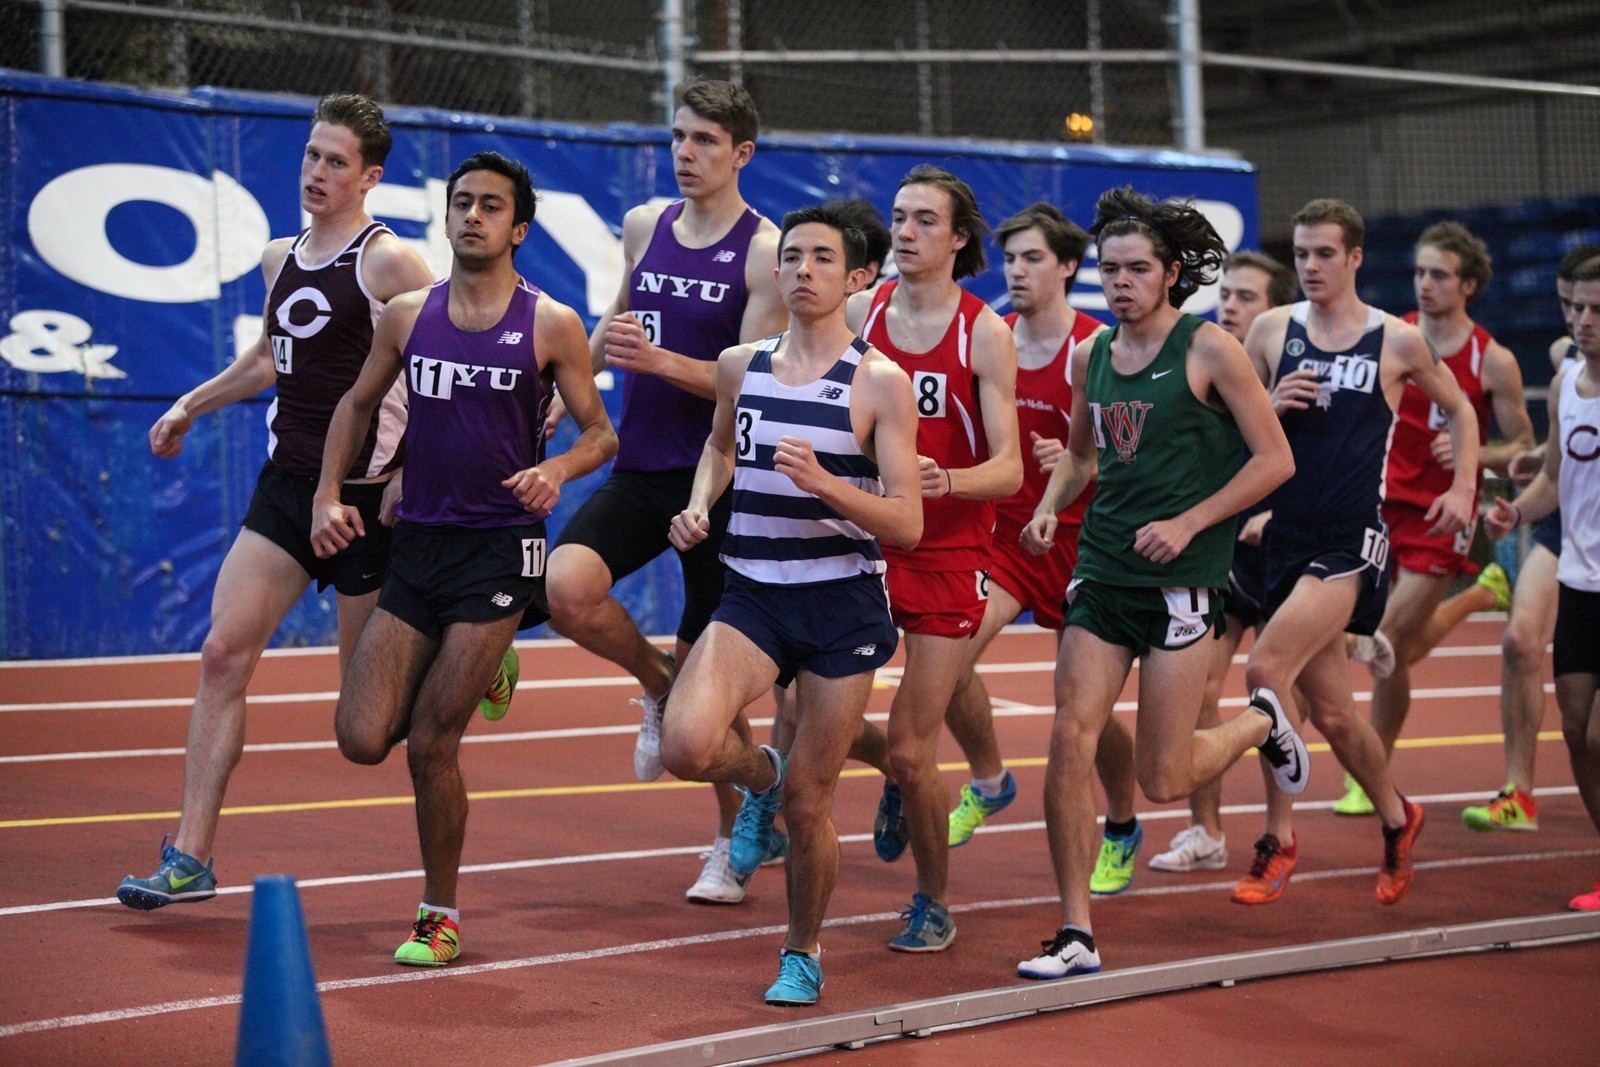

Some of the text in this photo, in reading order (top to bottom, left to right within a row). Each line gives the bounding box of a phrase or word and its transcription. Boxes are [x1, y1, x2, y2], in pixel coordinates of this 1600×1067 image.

[636, 271, 731, 303] NYU
[275, 286, 333, 339] C
[273, 337, 288, 371] 14
[413, 358, 443, 396] 11
[454, 362, 523, 391] YU
[1338, 359, 1370, 389] 10
[918, 375, 939, 417] 8
[738, 411, 753, 457] 3
[1100, 400, 1154, 454] W
[1566, 424, 1600, 462] C
[525, 540, 542, 575] 11
[1367, 533, 1387, 566] 10
